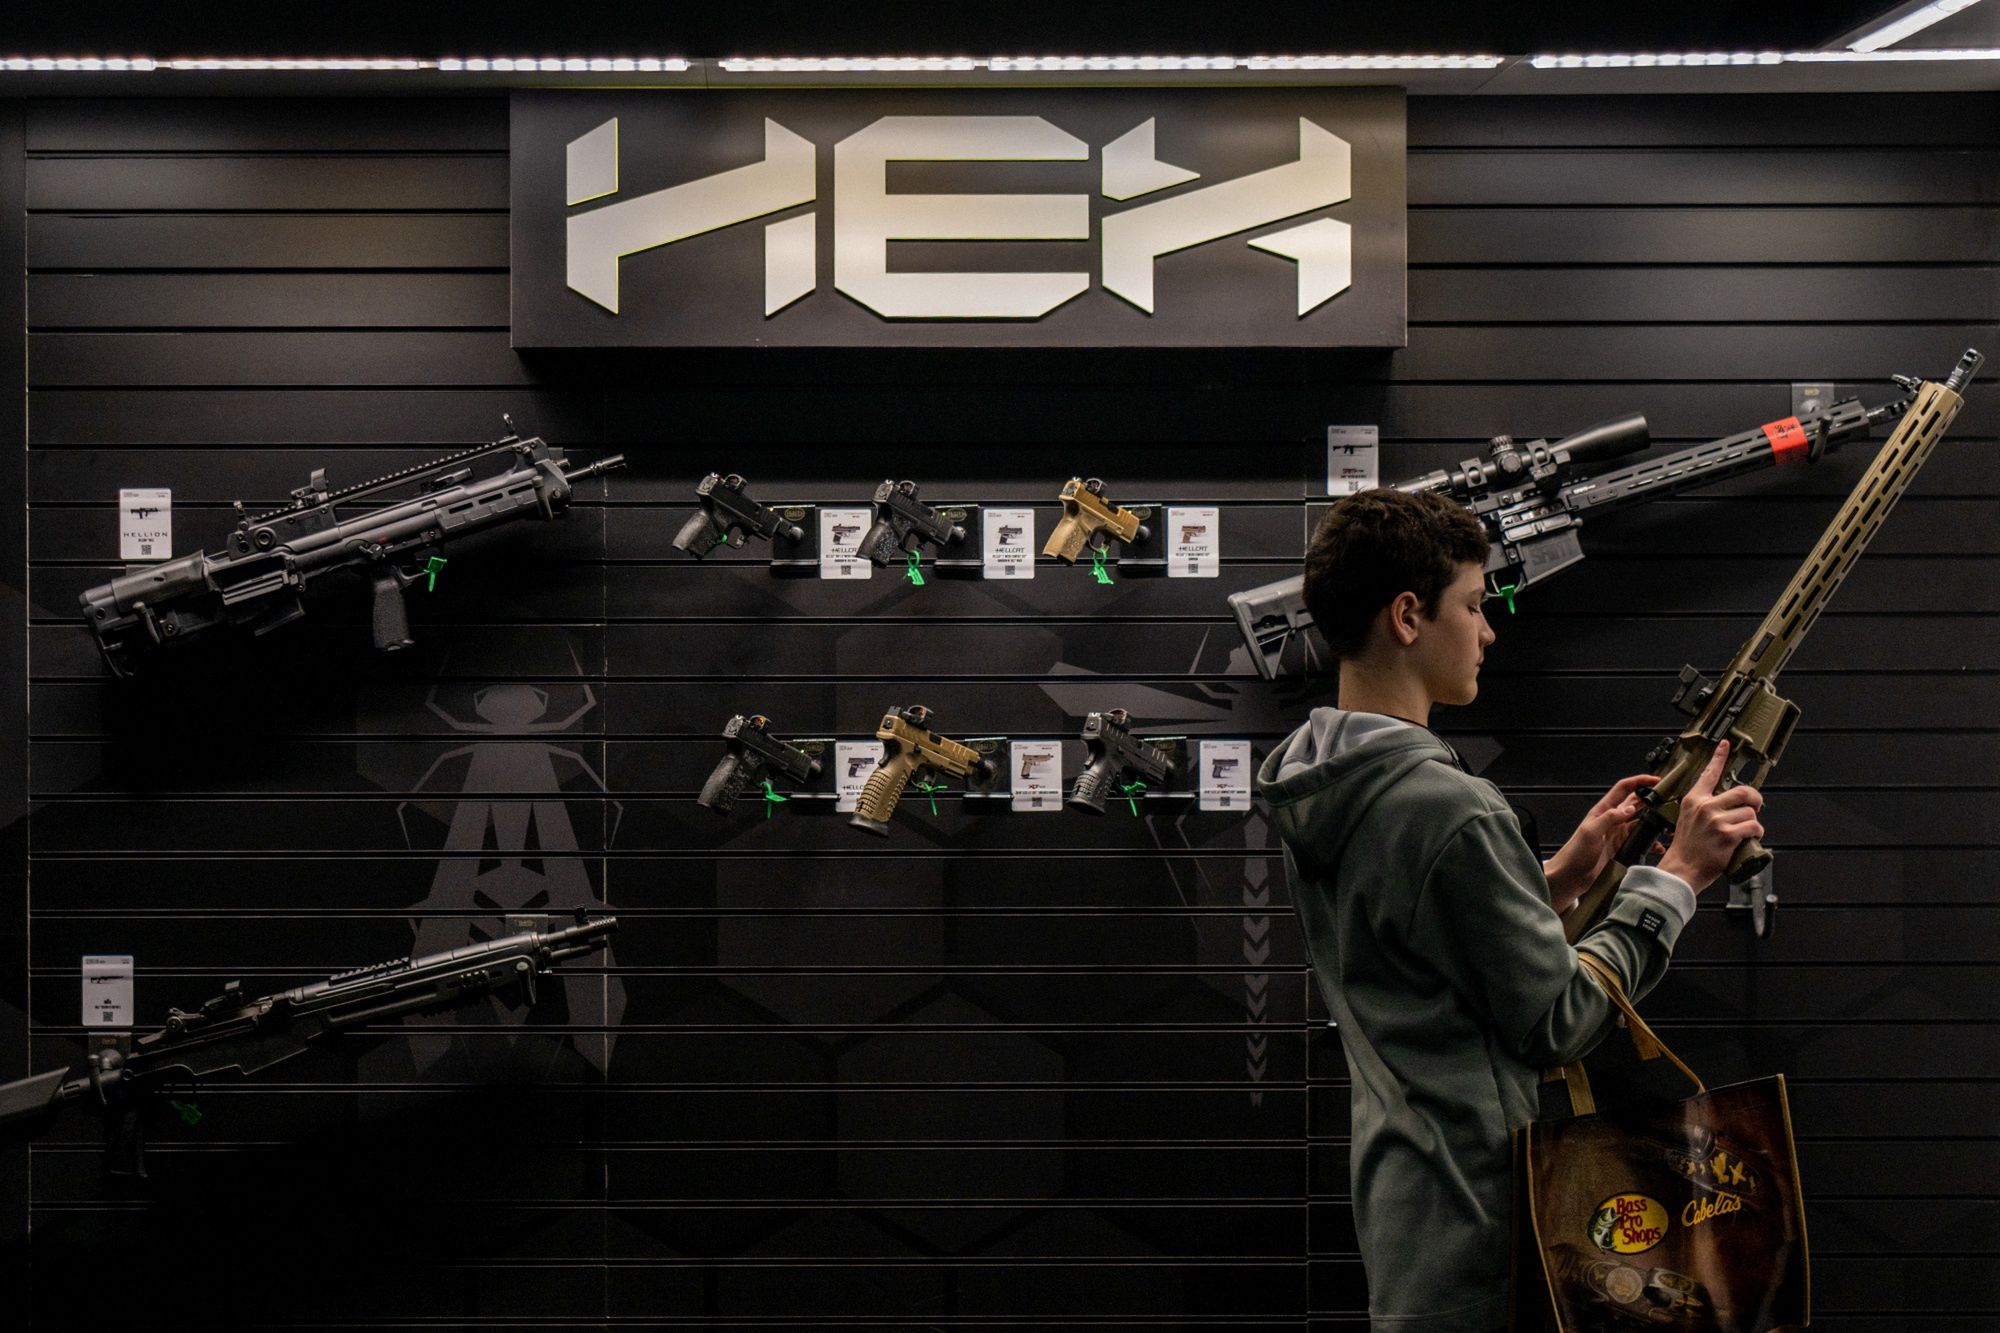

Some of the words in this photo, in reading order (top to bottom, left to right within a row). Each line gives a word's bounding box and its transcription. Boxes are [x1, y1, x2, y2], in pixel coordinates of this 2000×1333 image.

[566, 115, 1352, 319] HEX
[1616, 1198, 1648, 1215] Bass
[1620, 1214, 1643, 1229] Pro
[1622, 1227, 1662, 1245] Shops
